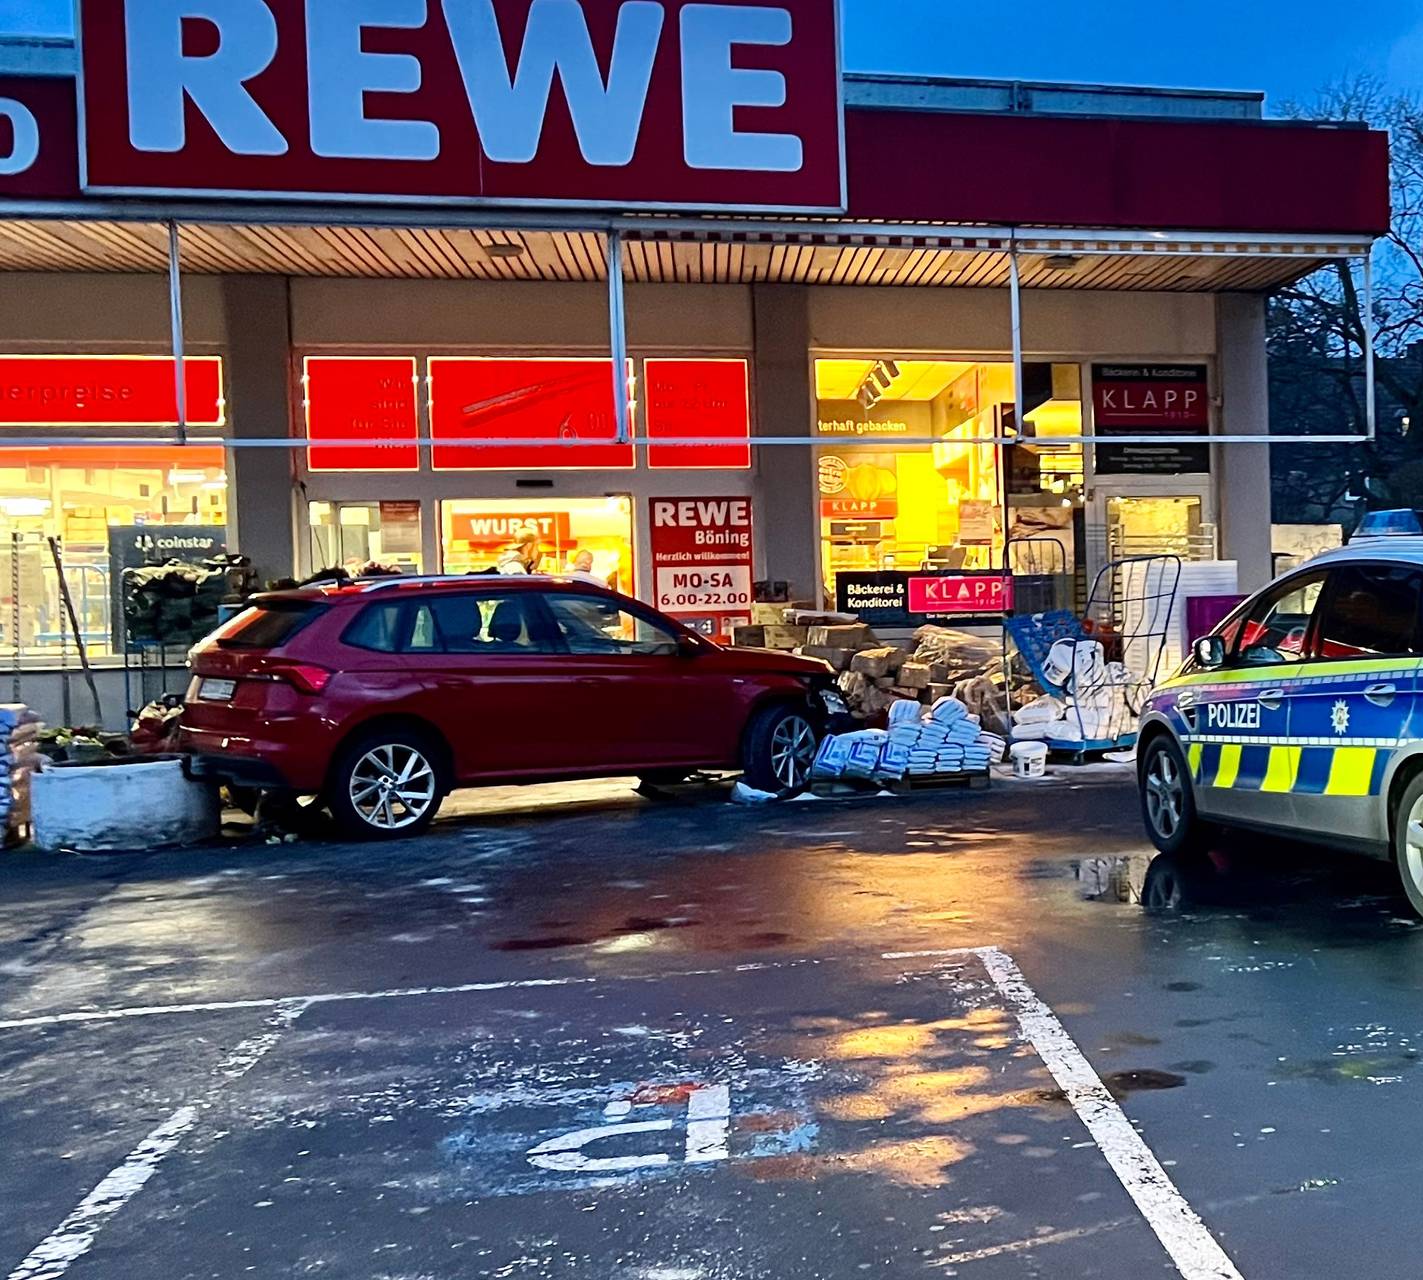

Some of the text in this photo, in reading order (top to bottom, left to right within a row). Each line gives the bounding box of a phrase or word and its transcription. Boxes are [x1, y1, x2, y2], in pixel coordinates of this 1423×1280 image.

[124, 0, 803, 173] REWE
[1102, 389, 1198, 409] KLAPP
[856, 420, 906, 434] gebacken
[832, 501, 877, 511] KLAPP
[654, 501, 749, 527] REWE
[470, 517, 552, 536] WURST
[157, 536, 213, 549] coinstar
[695, 530, 749, 547] Böning
[656, 552, 692, 561] Herzlich
[673, 573, 733, 588] MO-SA
[847, 584, 904, 595] Bäckerei &
[926, 582, 1002, 599] KLAPP
[661, 593, 748, 605] 6.00-22.00
[847, 597, 903, 608] Konditorei
[1208, 703, 1260, 728] POLIZEI
